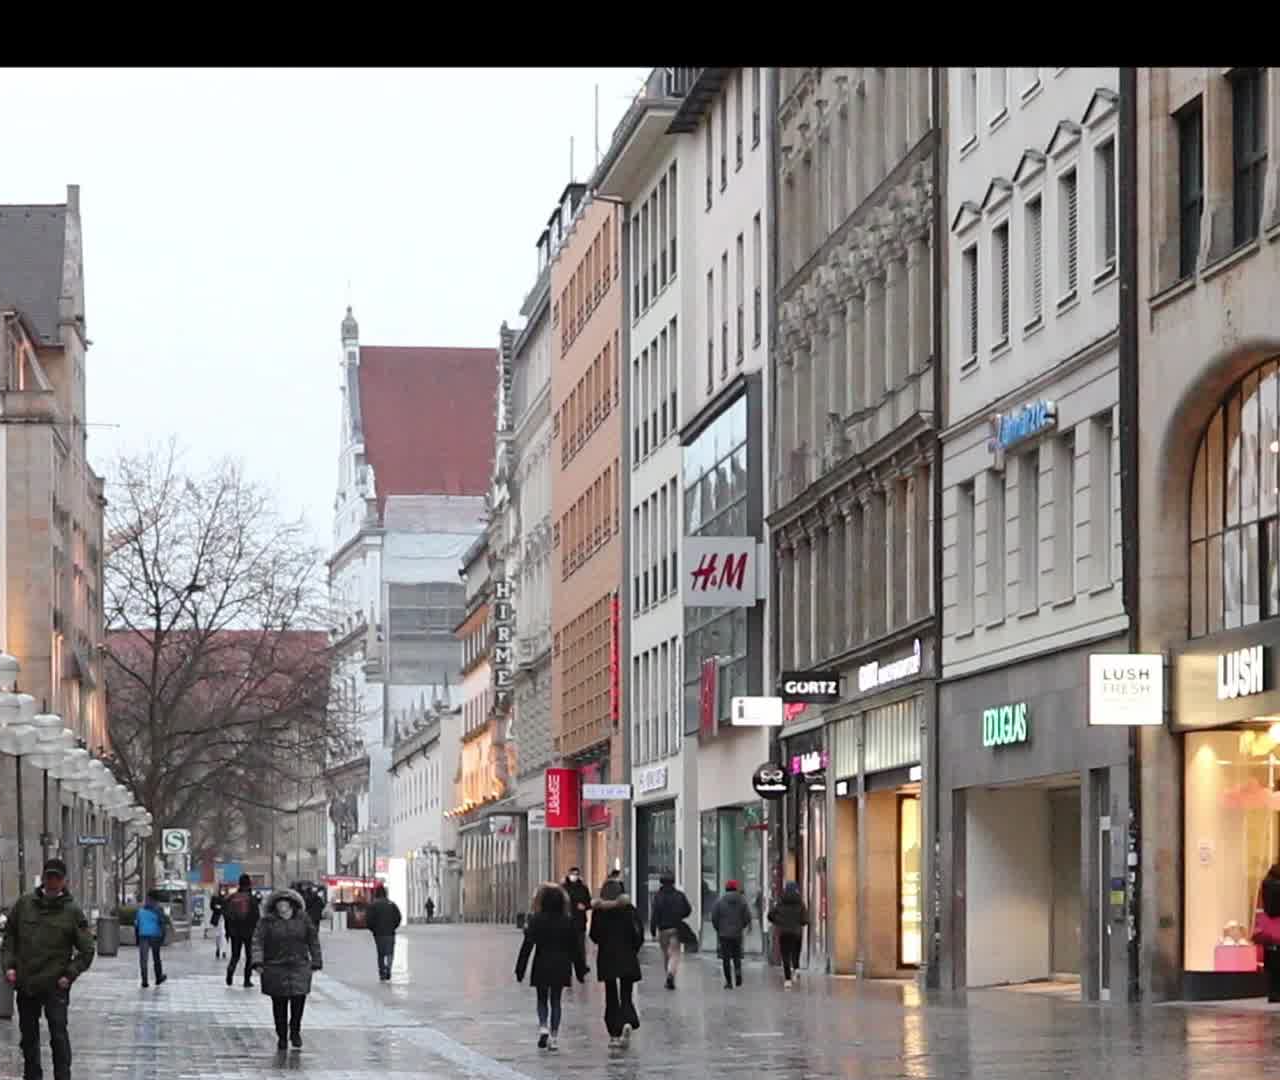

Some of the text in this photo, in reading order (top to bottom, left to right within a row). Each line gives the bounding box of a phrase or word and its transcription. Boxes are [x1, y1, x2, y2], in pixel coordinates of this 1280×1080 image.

[690, 552, 748, 591] H&M
[1103, 668, 1150, 681] LUSH
[1217, 644, 1263, 701] LUSH
[1103, 683, 1151, 695] FRESH
[983, 702, 1027, 747] DOUGLAS
[166, 831, 184, 851] S
